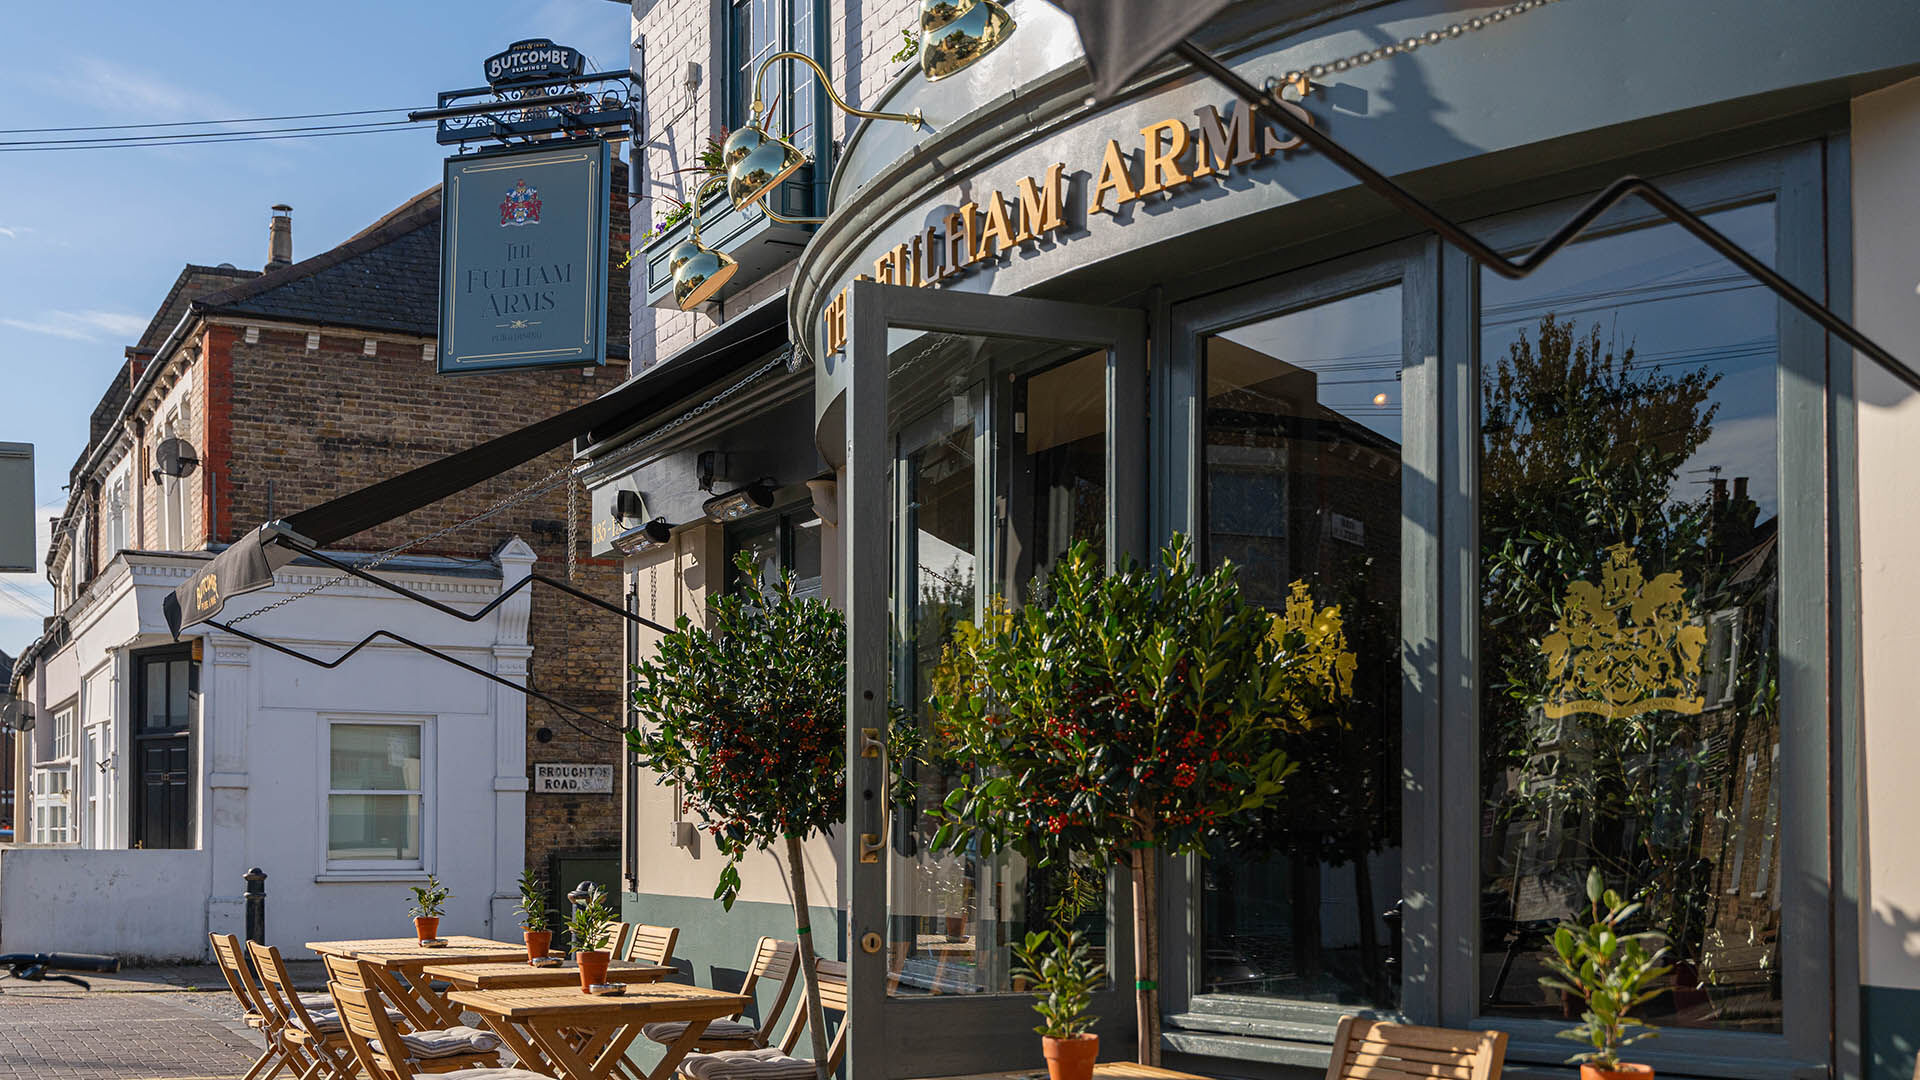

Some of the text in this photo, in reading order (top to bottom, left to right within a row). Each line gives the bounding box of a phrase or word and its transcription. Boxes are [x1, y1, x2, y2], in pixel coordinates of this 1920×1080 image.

[489, 50, 569, 77] BUTCOMBE
[512, 65, 540, 73] BREWING
[1088, 76, 1315, 215] ARMS
[505, 243, 532, 262] THE
[467, 264, 572, 293] FULHAM
[481, 291, 556, 319] ARMS
[539, 767, 609, 777] BROUGHTON
